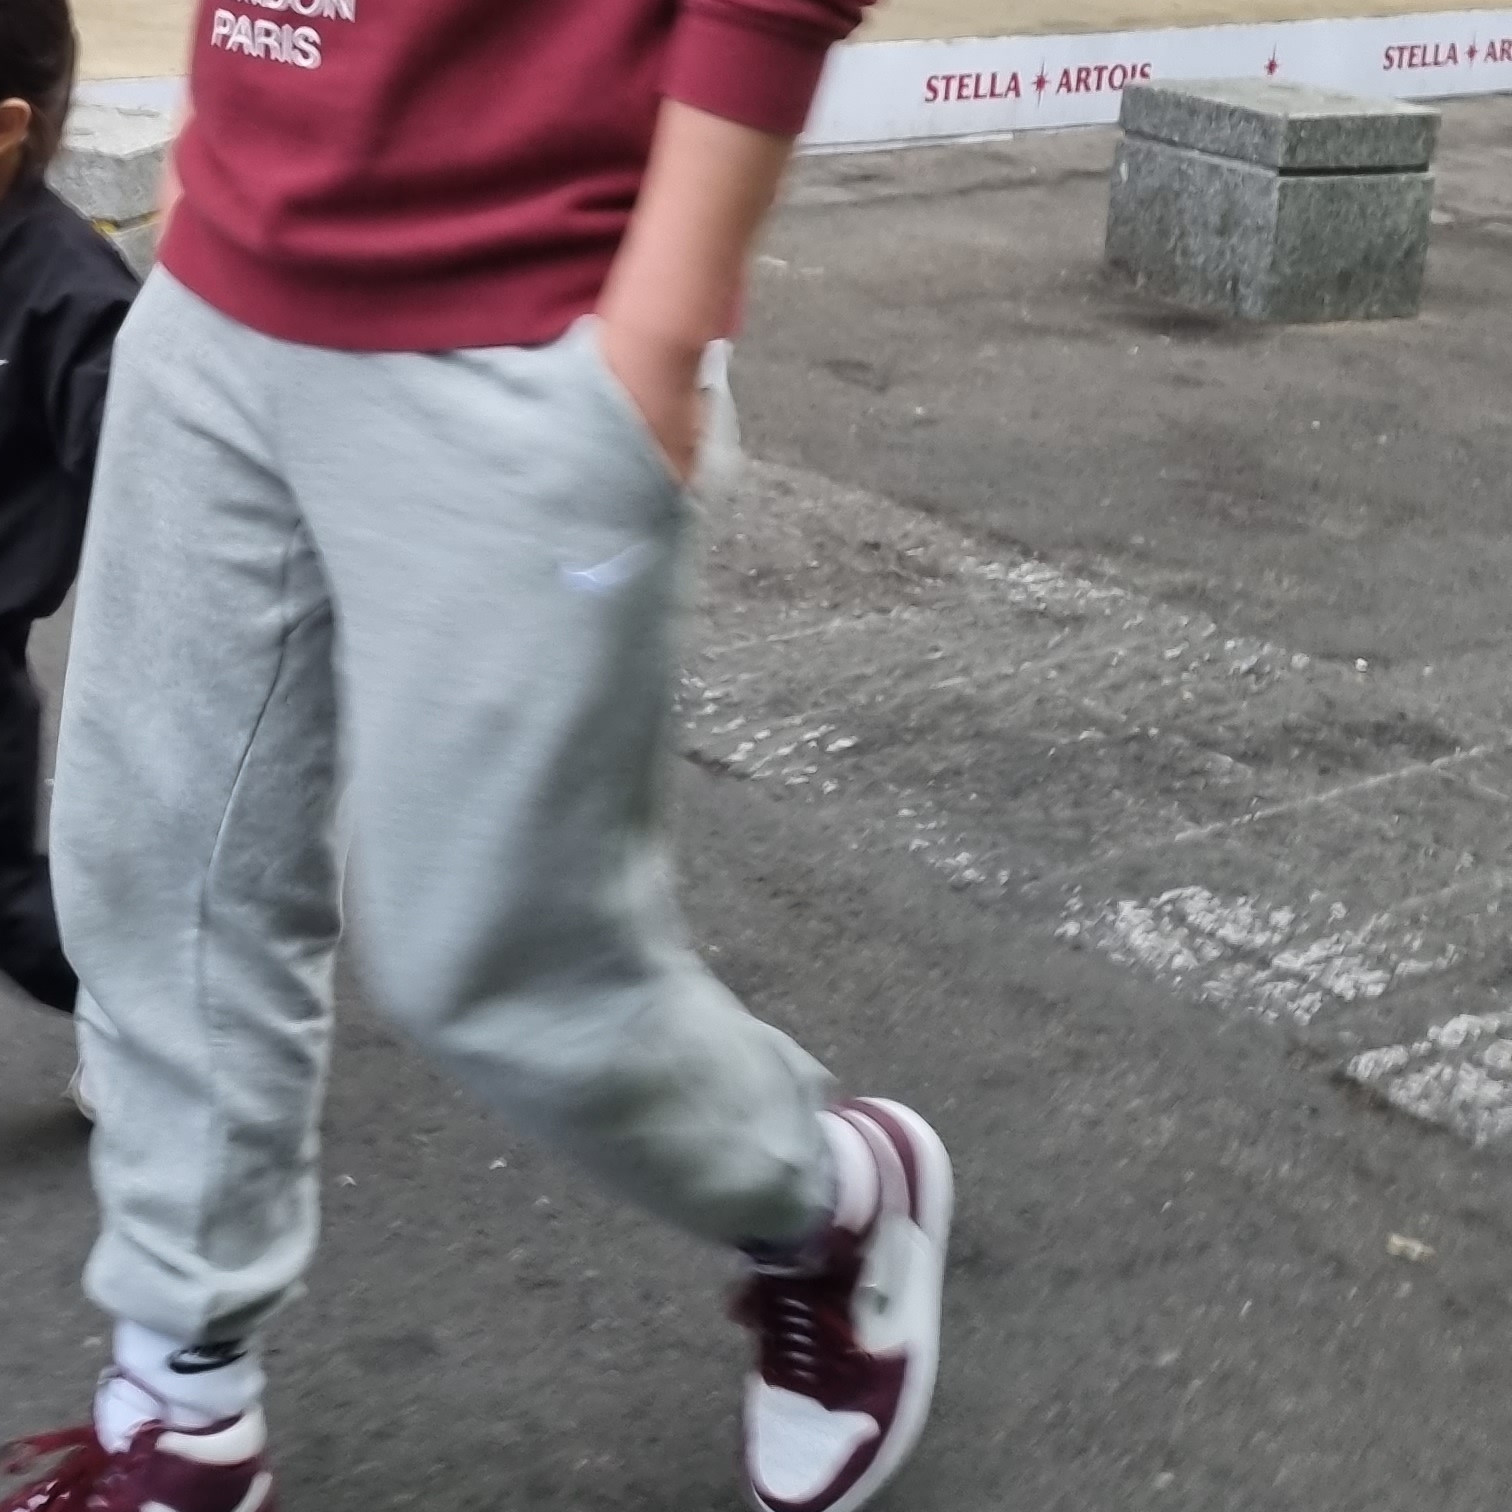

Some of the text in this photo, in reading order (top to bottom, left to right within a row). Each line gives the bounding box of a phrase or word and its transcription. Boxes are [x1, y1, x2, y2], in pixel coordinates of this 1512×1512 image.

[211, 7, 322, 70] PARIS
[1383, 41, 1459, 71] STELLA
[923, 71, 1022, 104] STELLA
